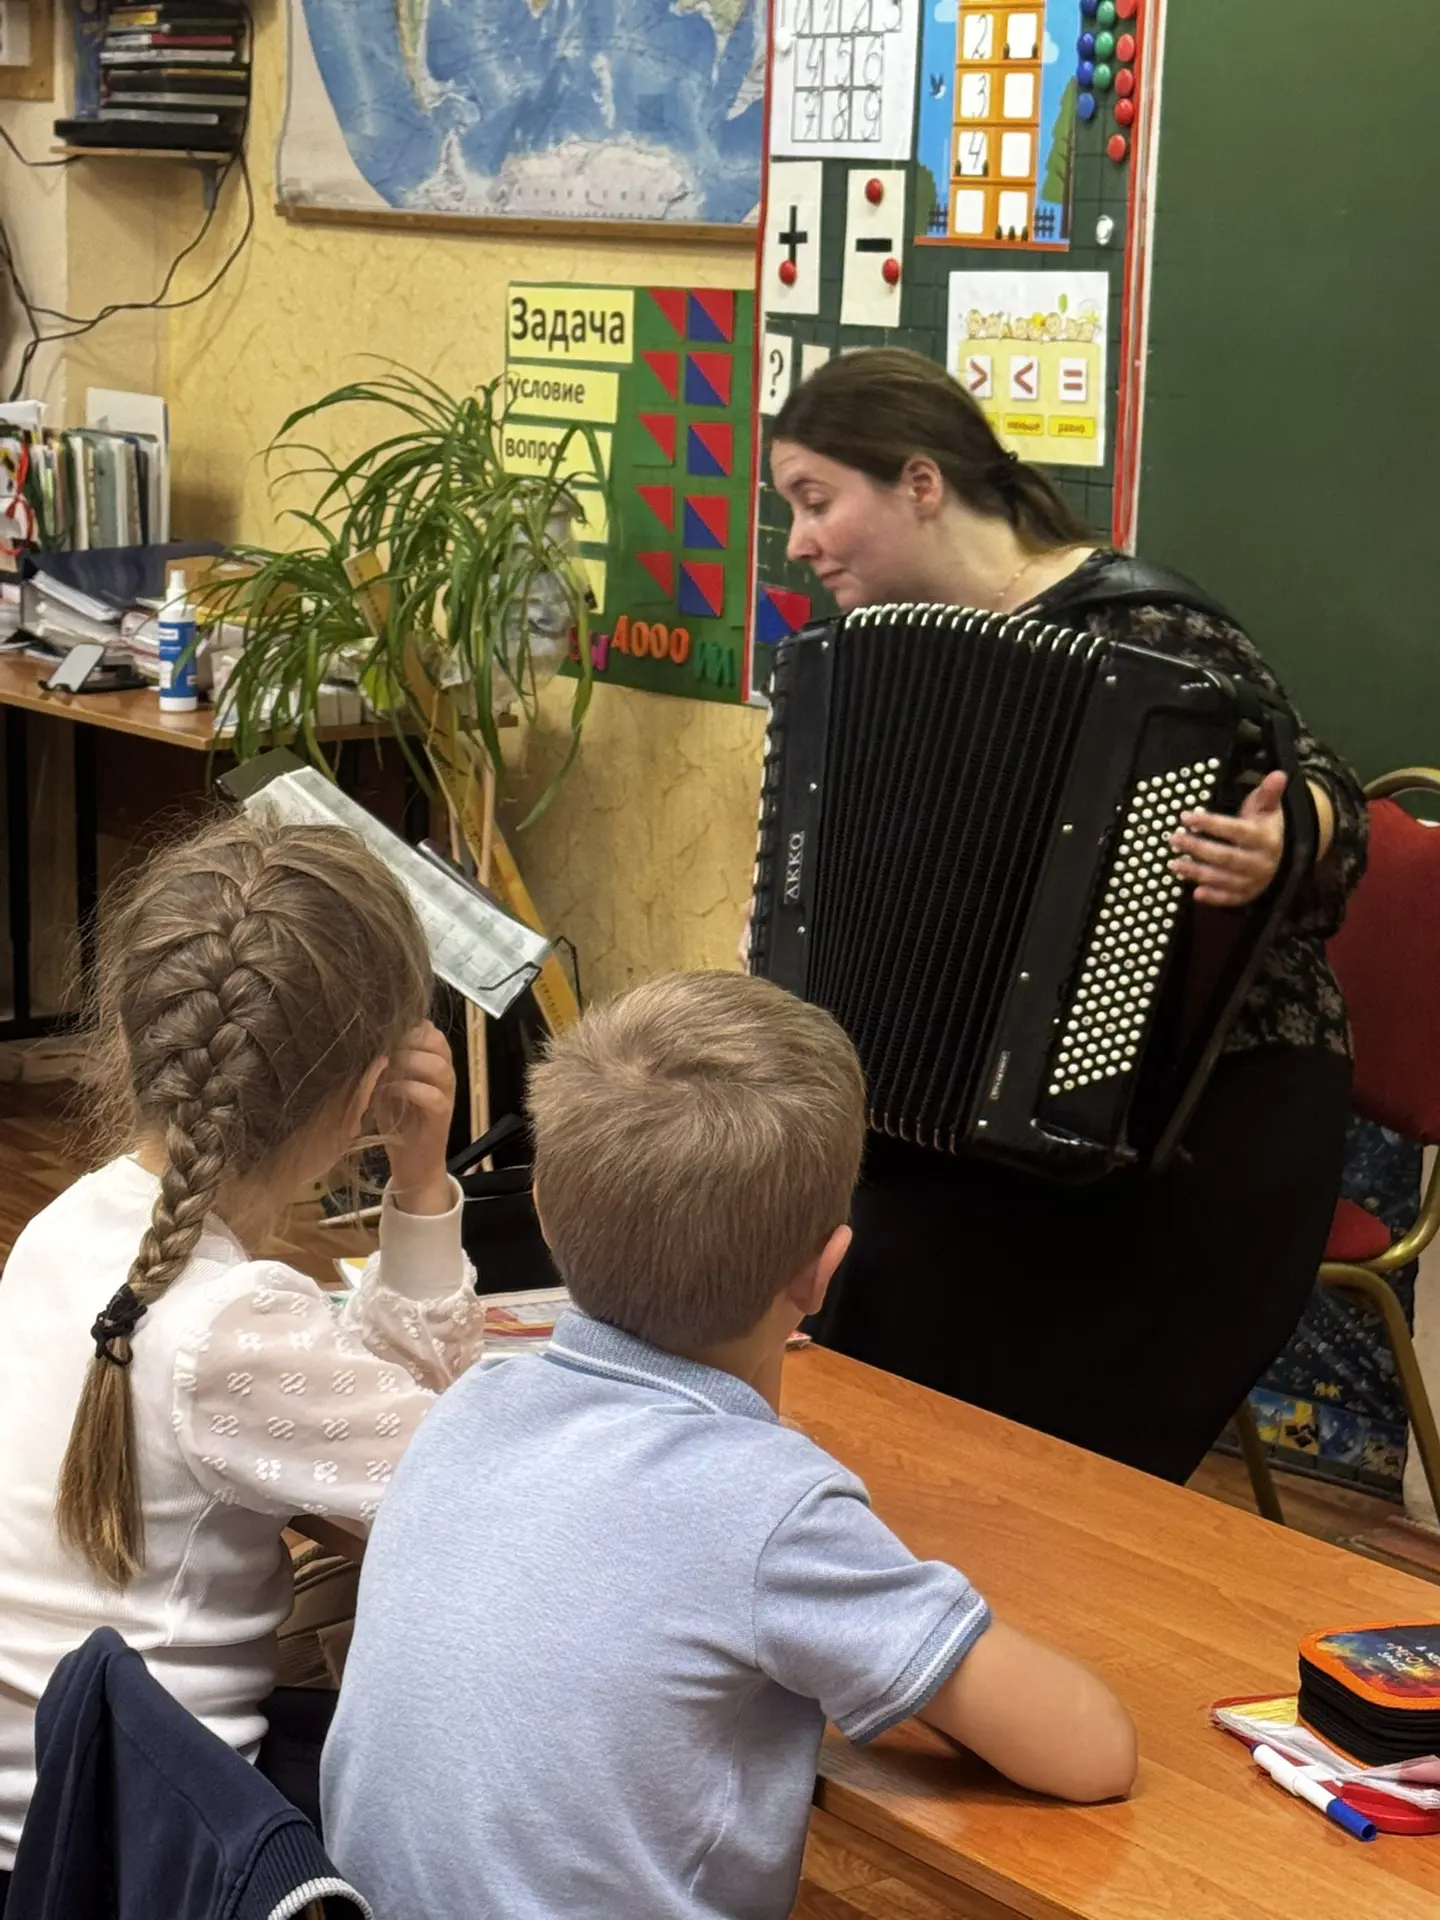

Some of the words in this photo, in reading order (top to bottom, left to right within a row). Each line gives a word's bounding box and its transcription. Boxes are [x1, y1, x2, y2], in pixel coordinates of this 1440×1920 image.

[972, 14, 988, 59] 2
[832, 89, 850, 140] 8
[972, 74, 987, 119] 3
[968, 131, 985, 169] 4
[511, 296, 625, 352] Задача
[508, 377, 586, 405] условие
[769, 349, 784, 398] ?
[505, 437, 567, 467] вопро
[783, 830, 805, 904] AKKO
